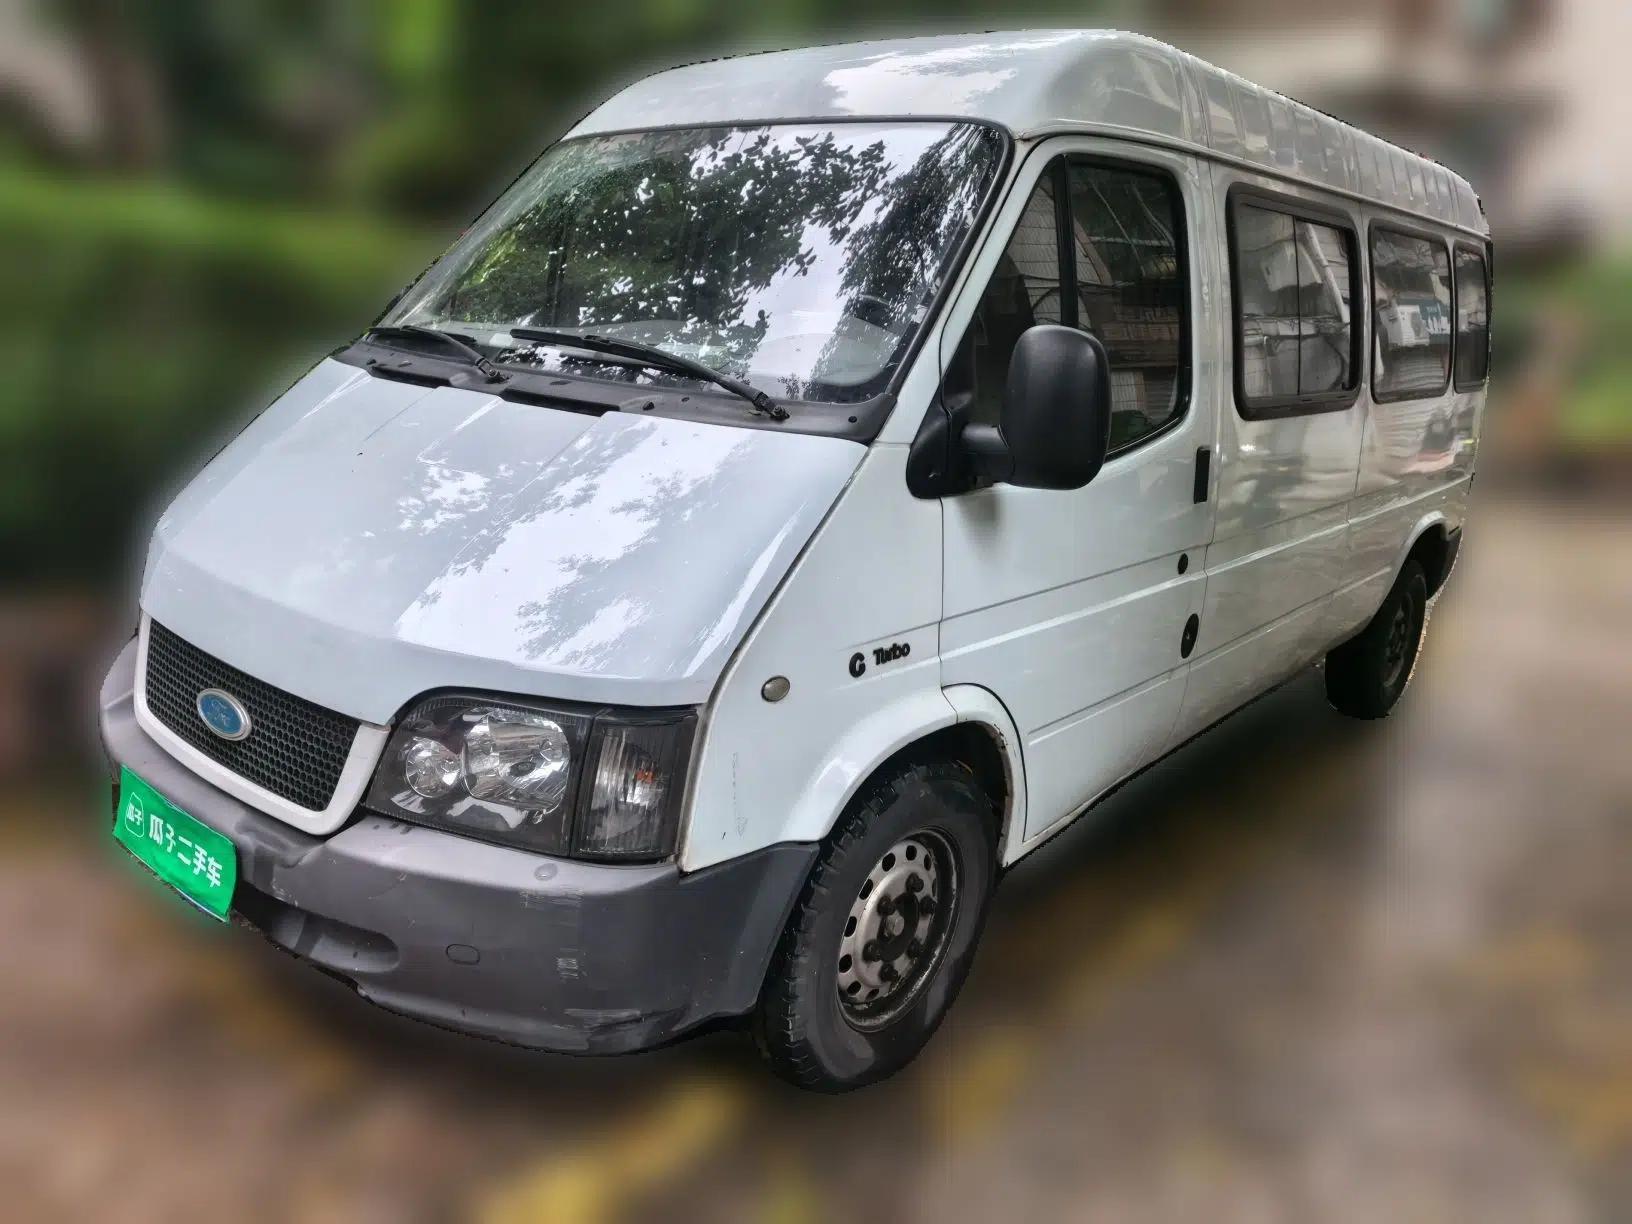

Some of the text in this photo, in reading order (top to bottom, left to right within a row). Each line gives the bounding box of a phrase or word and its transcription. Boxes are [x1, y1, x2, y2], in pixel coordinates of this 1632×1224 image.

[873, 643, 911, 666] Turbo
[149, 814, 223, 888] 瓜子二手车
